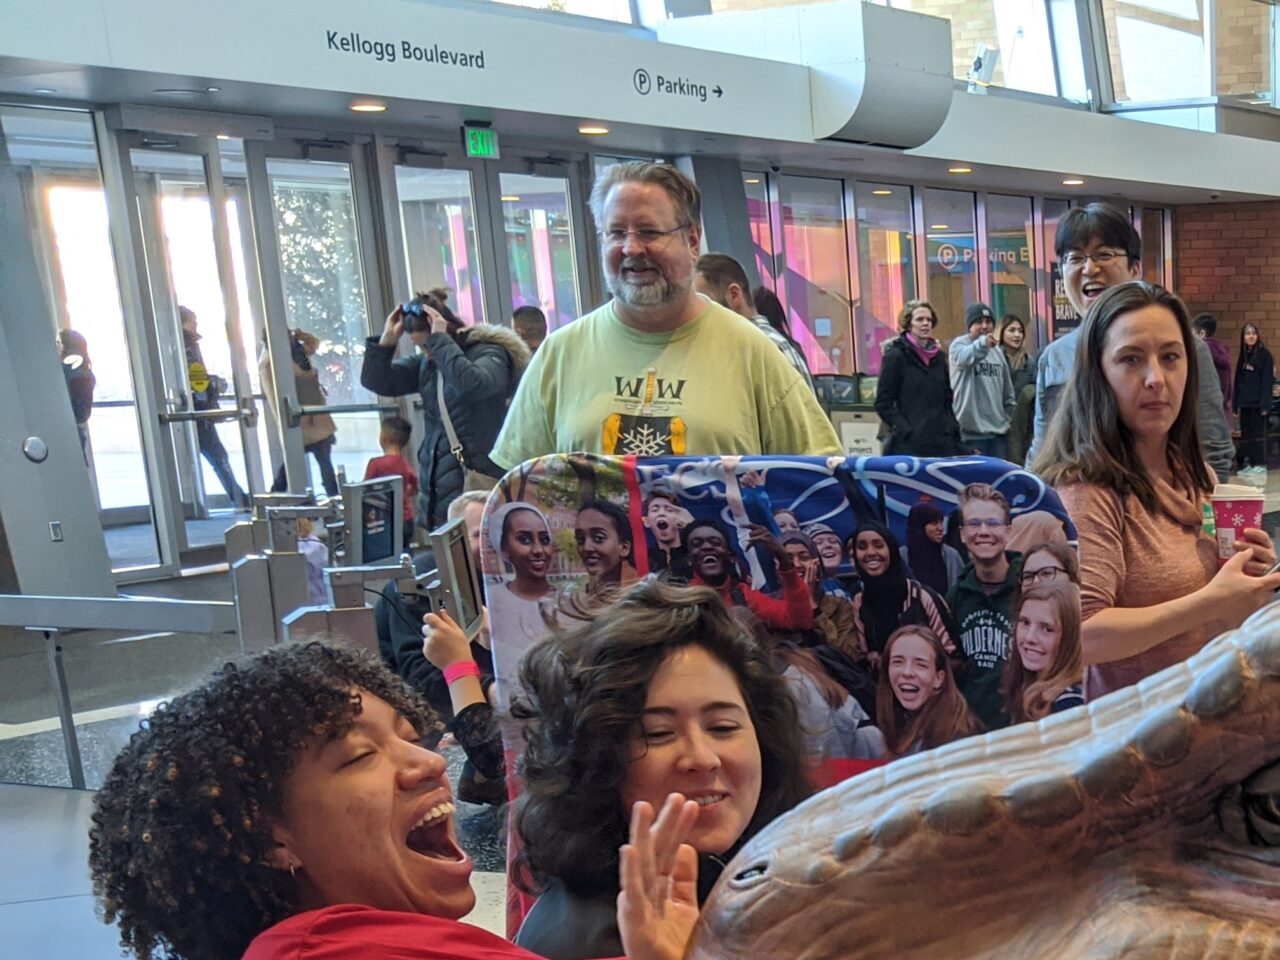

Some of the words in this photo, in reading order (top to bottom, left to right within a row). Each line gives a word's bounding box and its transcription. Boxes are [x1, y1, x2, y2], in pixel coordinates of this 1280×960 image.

[326, 30, 396, 62] Kellogg
[401, 41, 485, 69] Boulevard
[657, 76, 708, 101] Parking
[469, 128, 497, 156] EXIT
